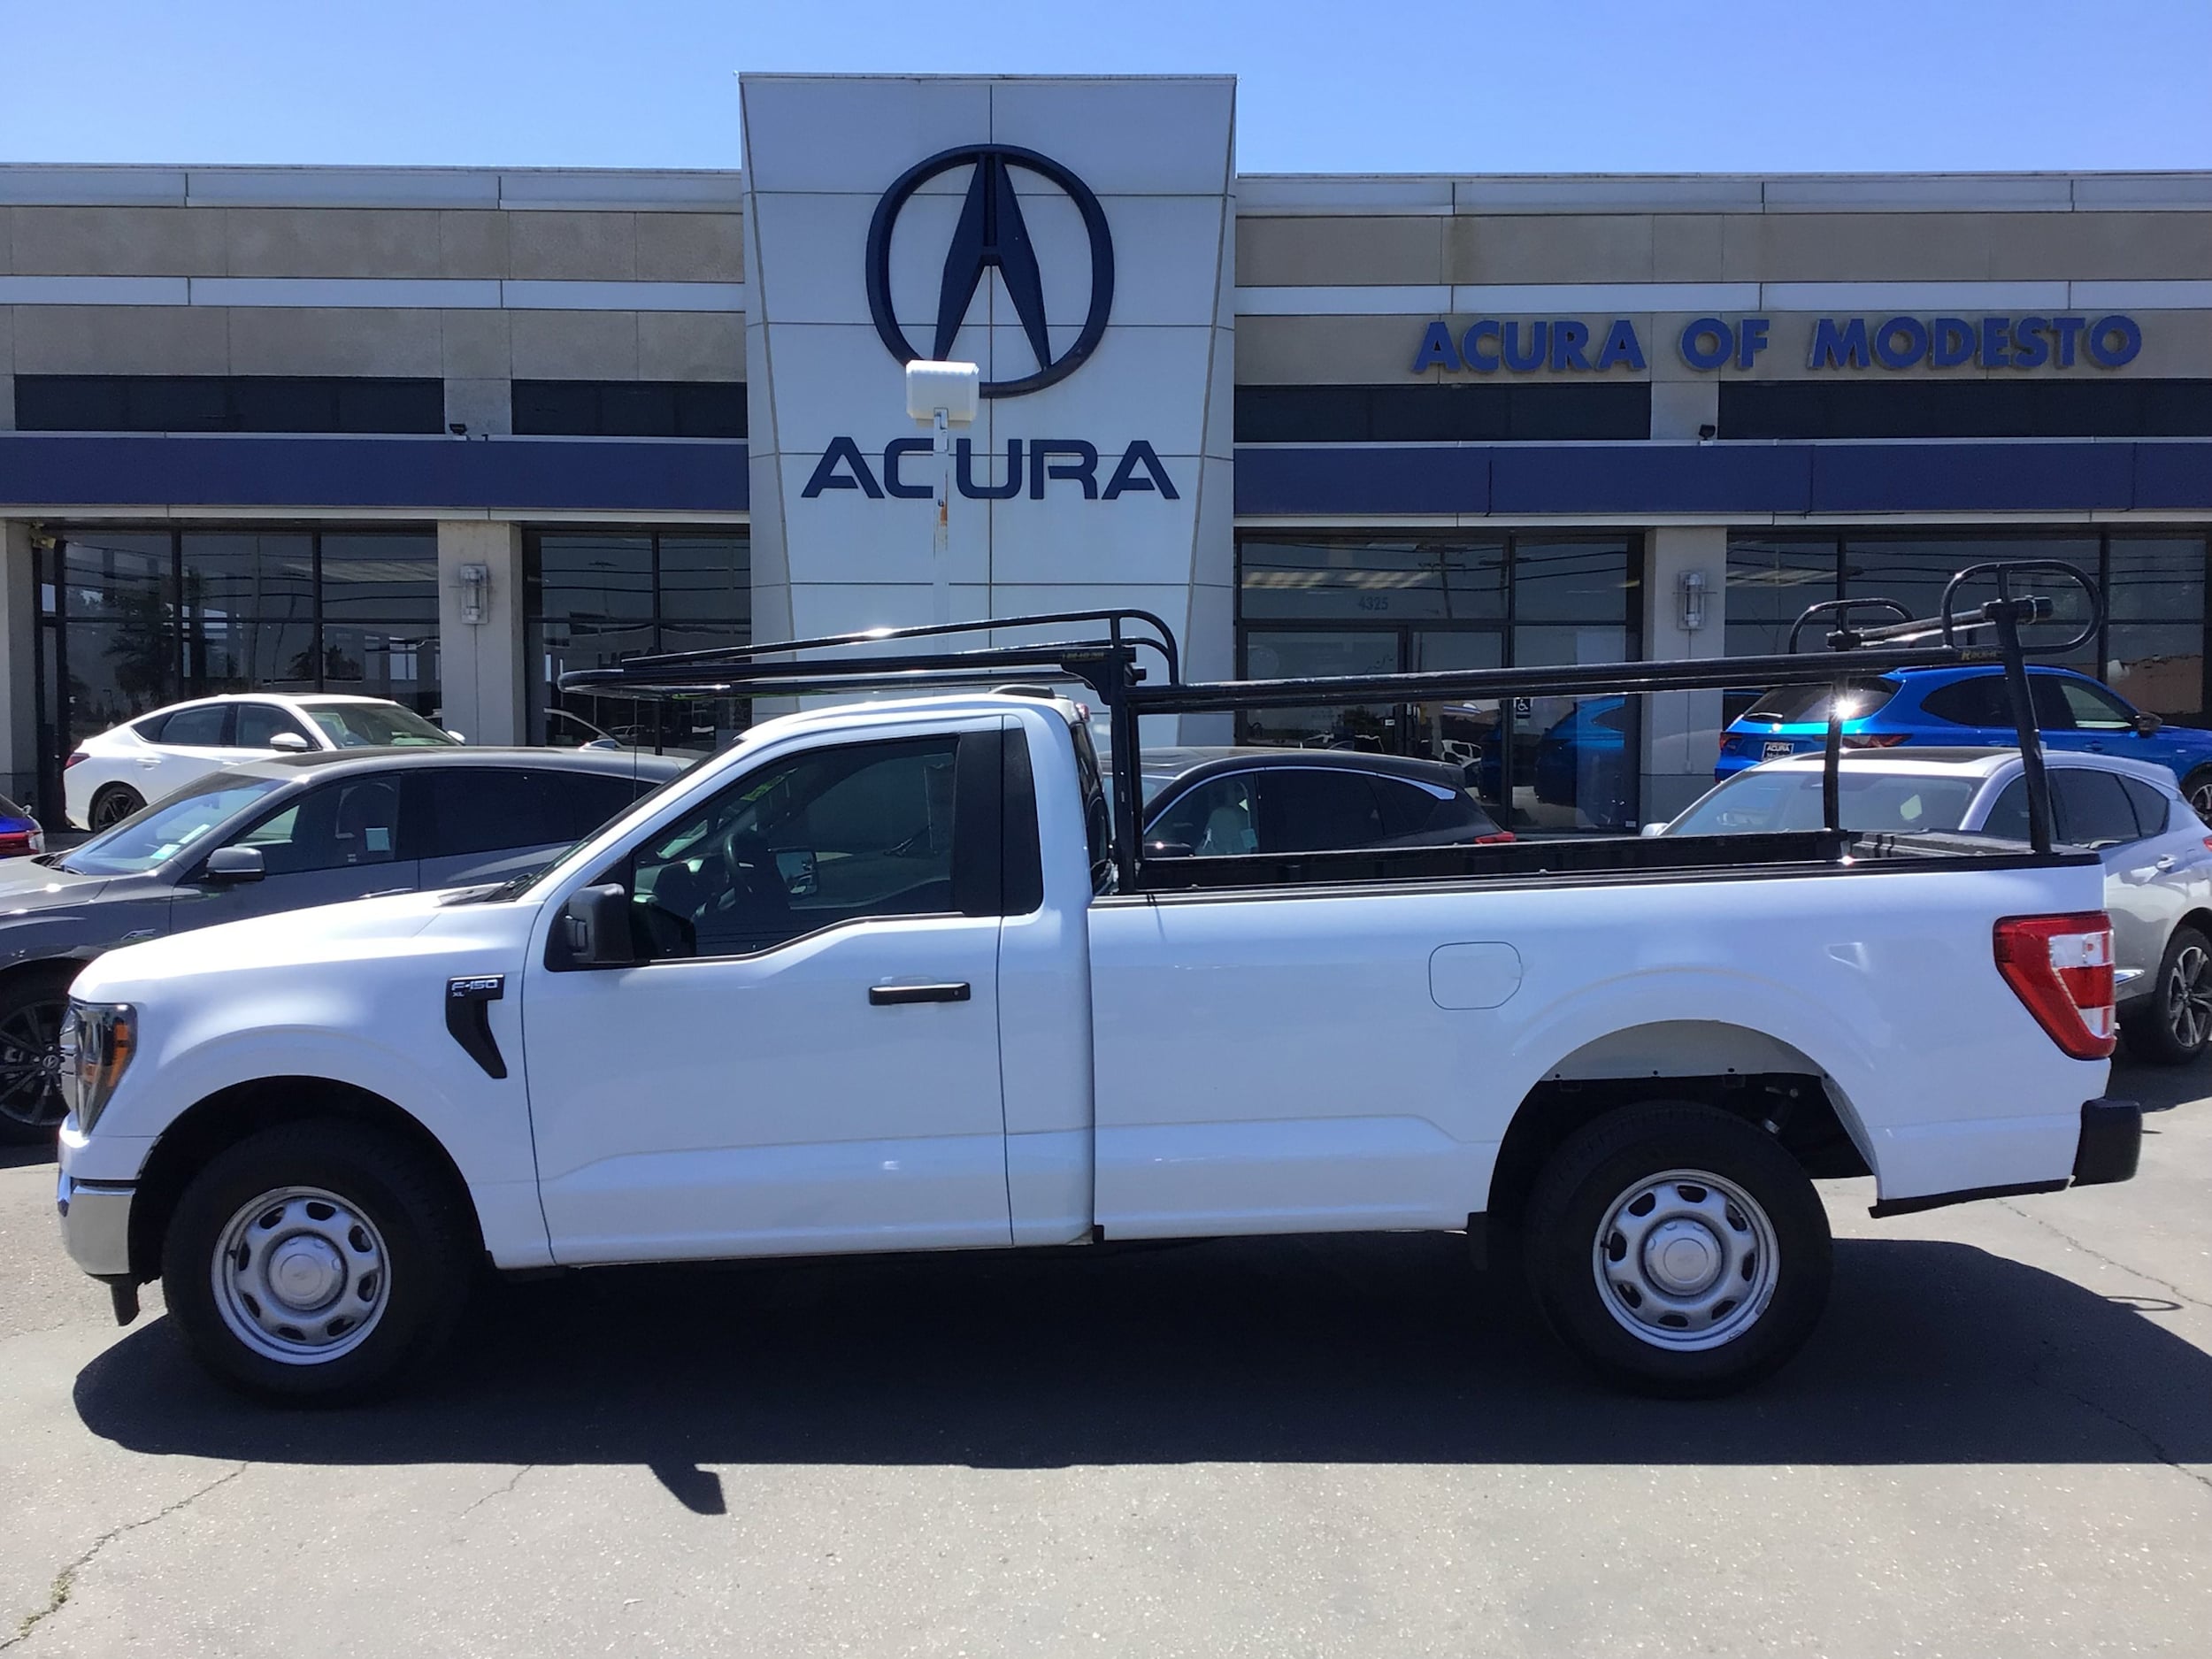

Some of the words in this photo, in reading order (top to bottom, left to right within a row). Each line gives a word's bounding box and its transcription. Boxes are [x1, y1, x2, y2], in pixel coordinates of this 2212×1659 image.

[1411, 319, 1647, 373] ACURA
[1681, 318, 1770, 371] OF
[1808, 316, 2143, 370] MODESTO
[802, 436, 1179, 500] ACURA
[1358, 595, 1388, 611] 4325
[451, 979, 498, 991] F-150
